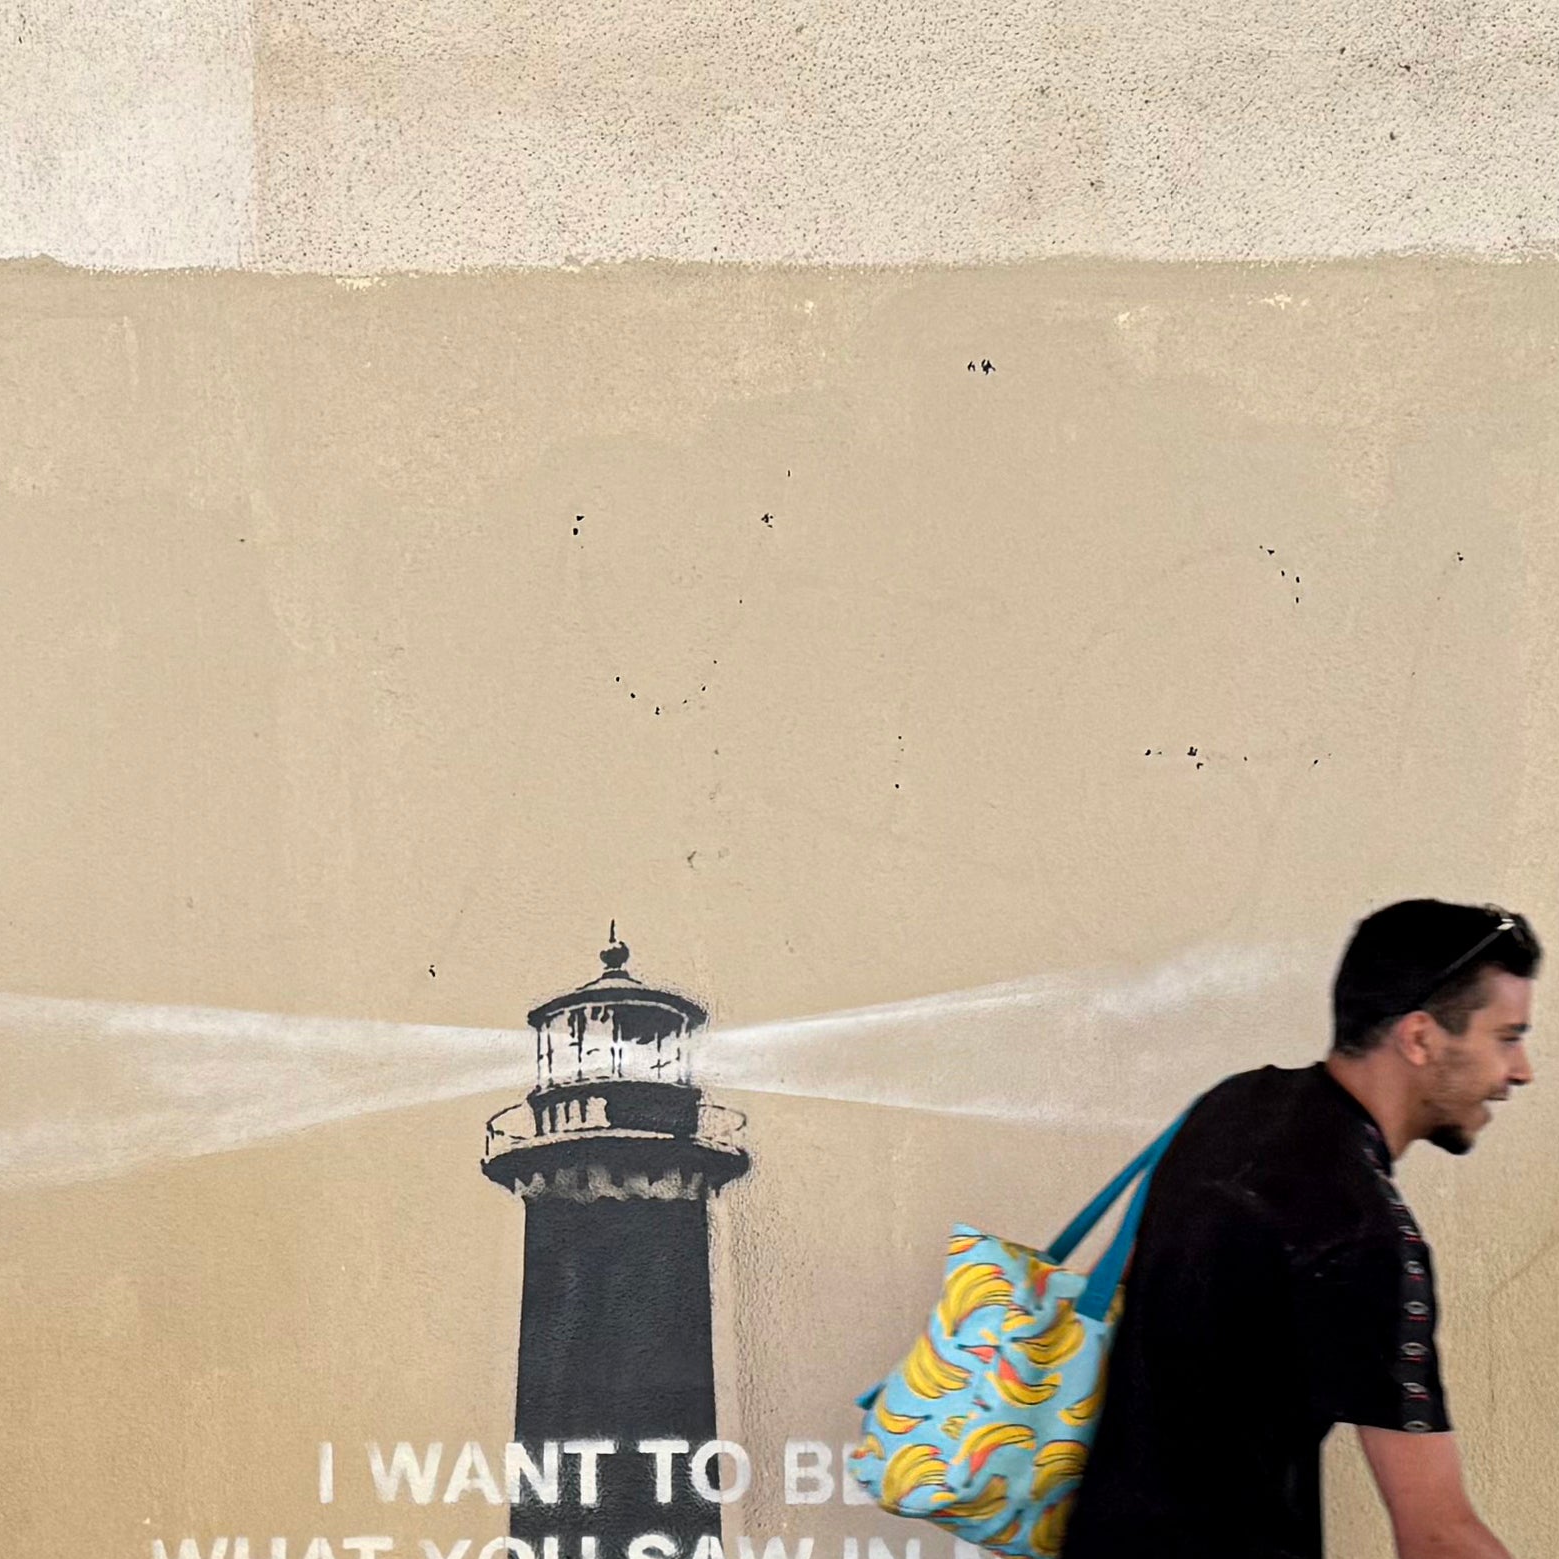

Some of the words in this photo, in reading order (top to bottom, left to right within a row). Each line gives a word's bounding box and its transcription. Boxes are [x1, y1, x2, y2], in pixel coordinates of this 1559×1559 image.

[318, 1441, 334, 1504] I
[366, 1440, 616, 1505] WANT
[638, 1439, 752, 1504] TO
